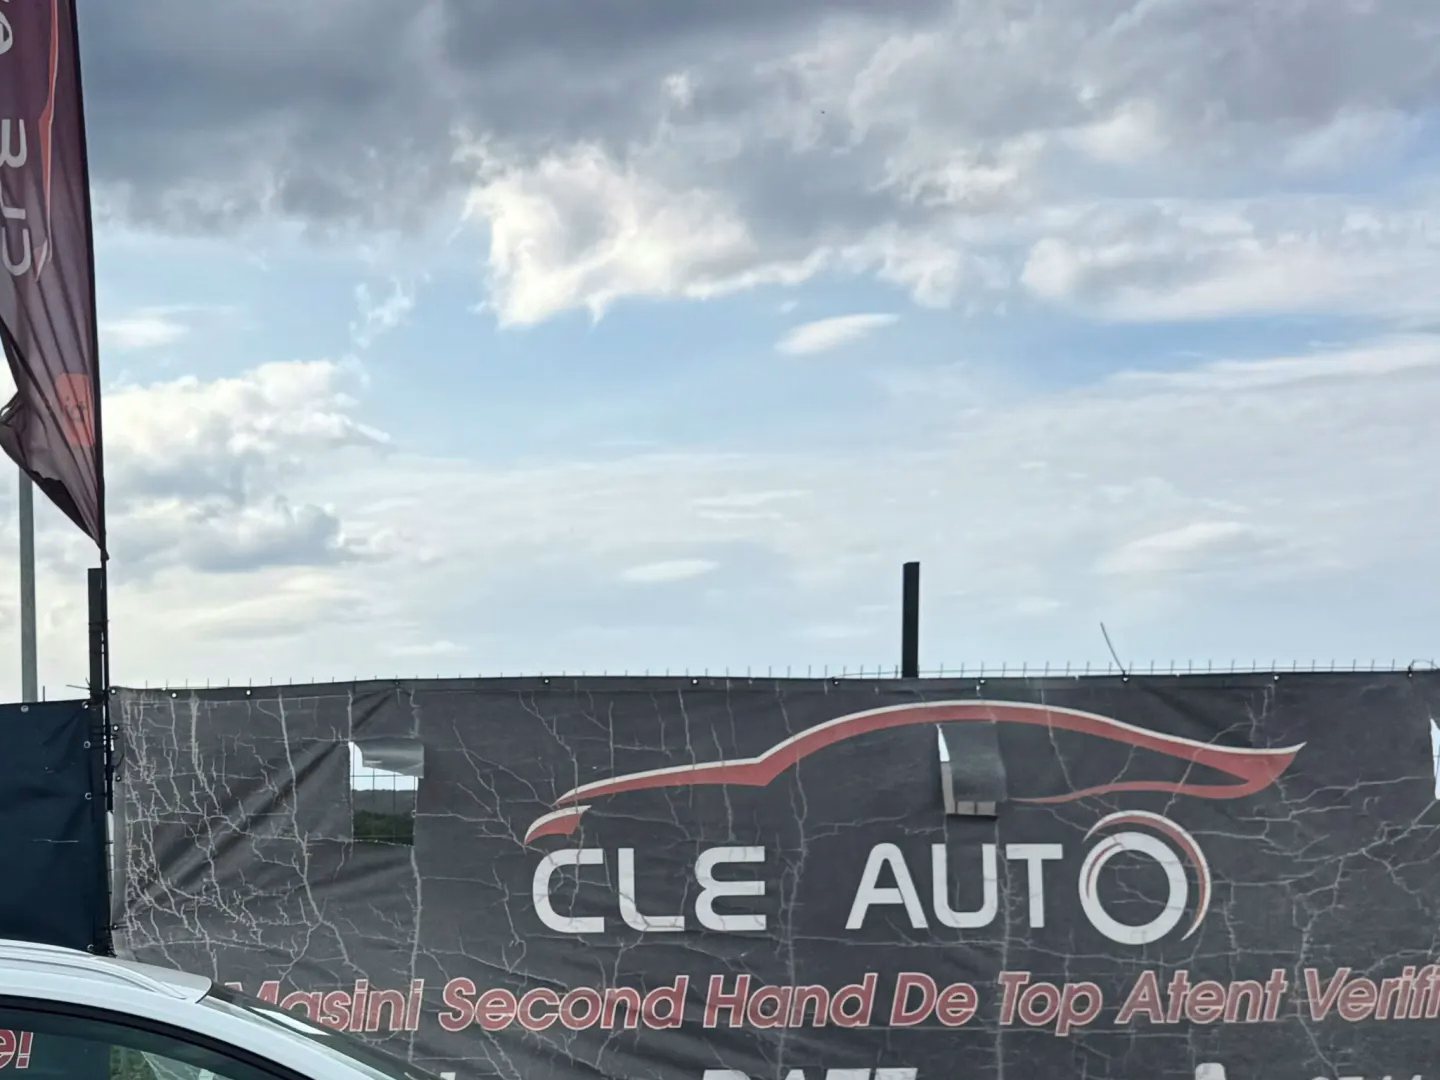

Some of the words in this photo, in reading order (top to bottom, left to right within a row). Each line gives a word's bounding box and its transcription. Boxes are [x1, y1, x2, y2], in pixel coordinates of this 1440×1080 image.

[531, 845, 767, 933] CLE
[844, 831, 1190, 945] AUTO
[438, 977, 690, 1032] Second
[702, 973, 877, 1029] Hand
[889, 972, 979, 1027] De
[998, 970, 1104, 1037] Top
[1113, 968, 1289, 1025] Atent
